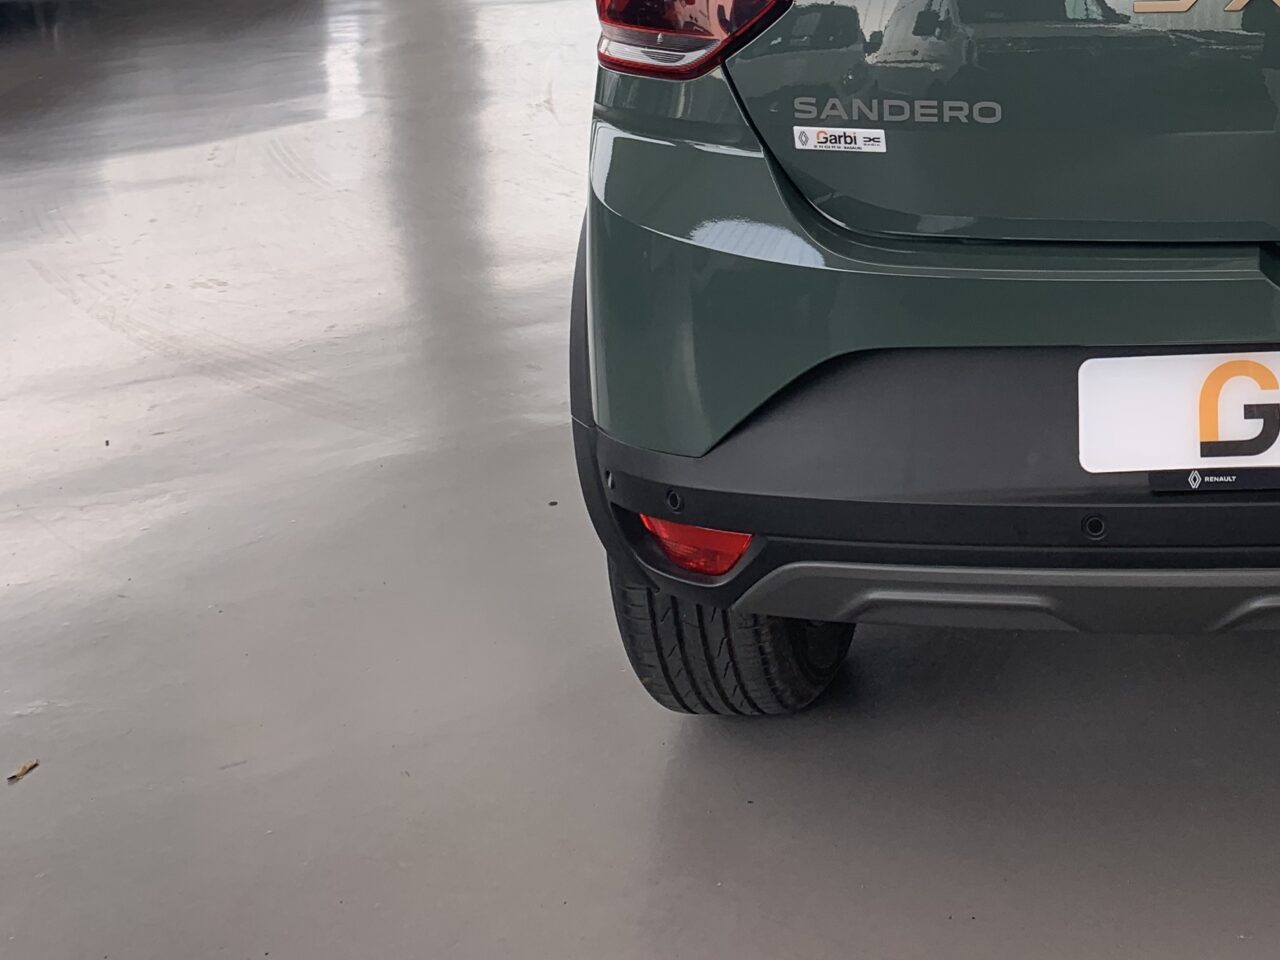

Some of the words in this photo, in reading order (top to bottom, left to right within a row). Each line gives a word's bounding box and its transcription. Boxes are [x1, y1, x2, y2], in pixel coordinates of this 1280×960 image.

[793, 96, 1002, 124] SANDERO
[816, 130, 858, 145] Garbi
[1204, 475, 1237, 483] RENAULT
